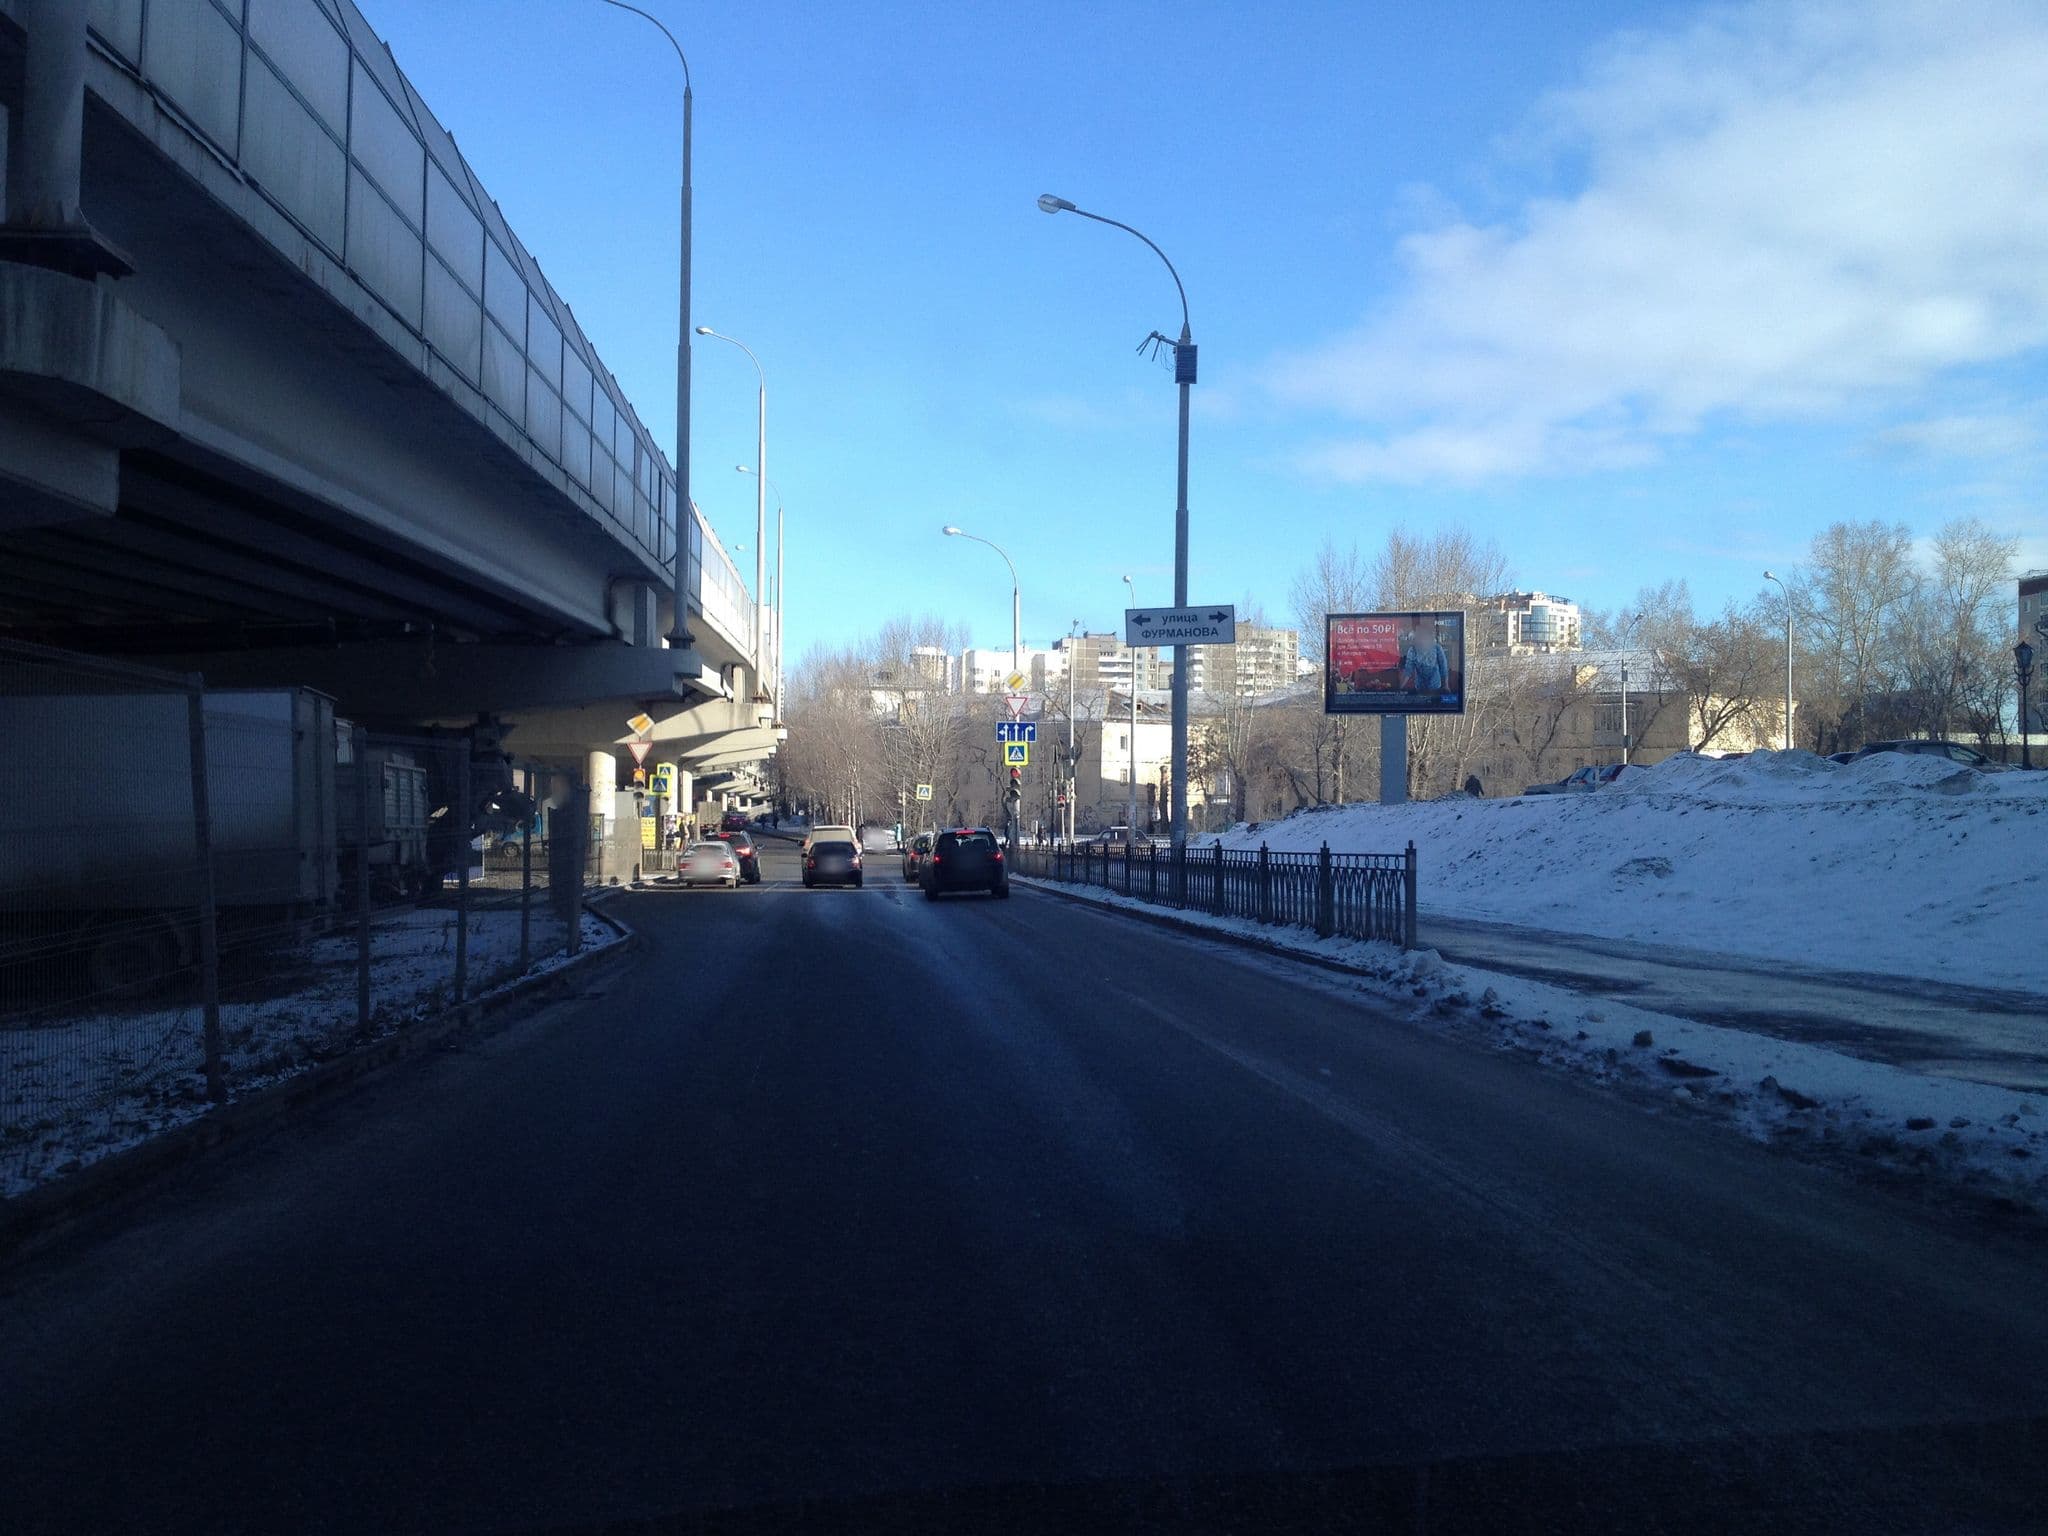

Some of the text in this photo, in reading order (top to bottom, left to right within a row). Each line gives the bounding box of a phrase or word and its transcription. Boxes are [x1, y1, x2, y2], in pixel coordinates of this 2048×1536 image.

[1161, 614, 1198, 626] улица
[1141, 627, 1219, 639] ФУРМАНОВА
[1337, 624, 1354, 634] Всё
[1356, 626, 1370, 634] по
